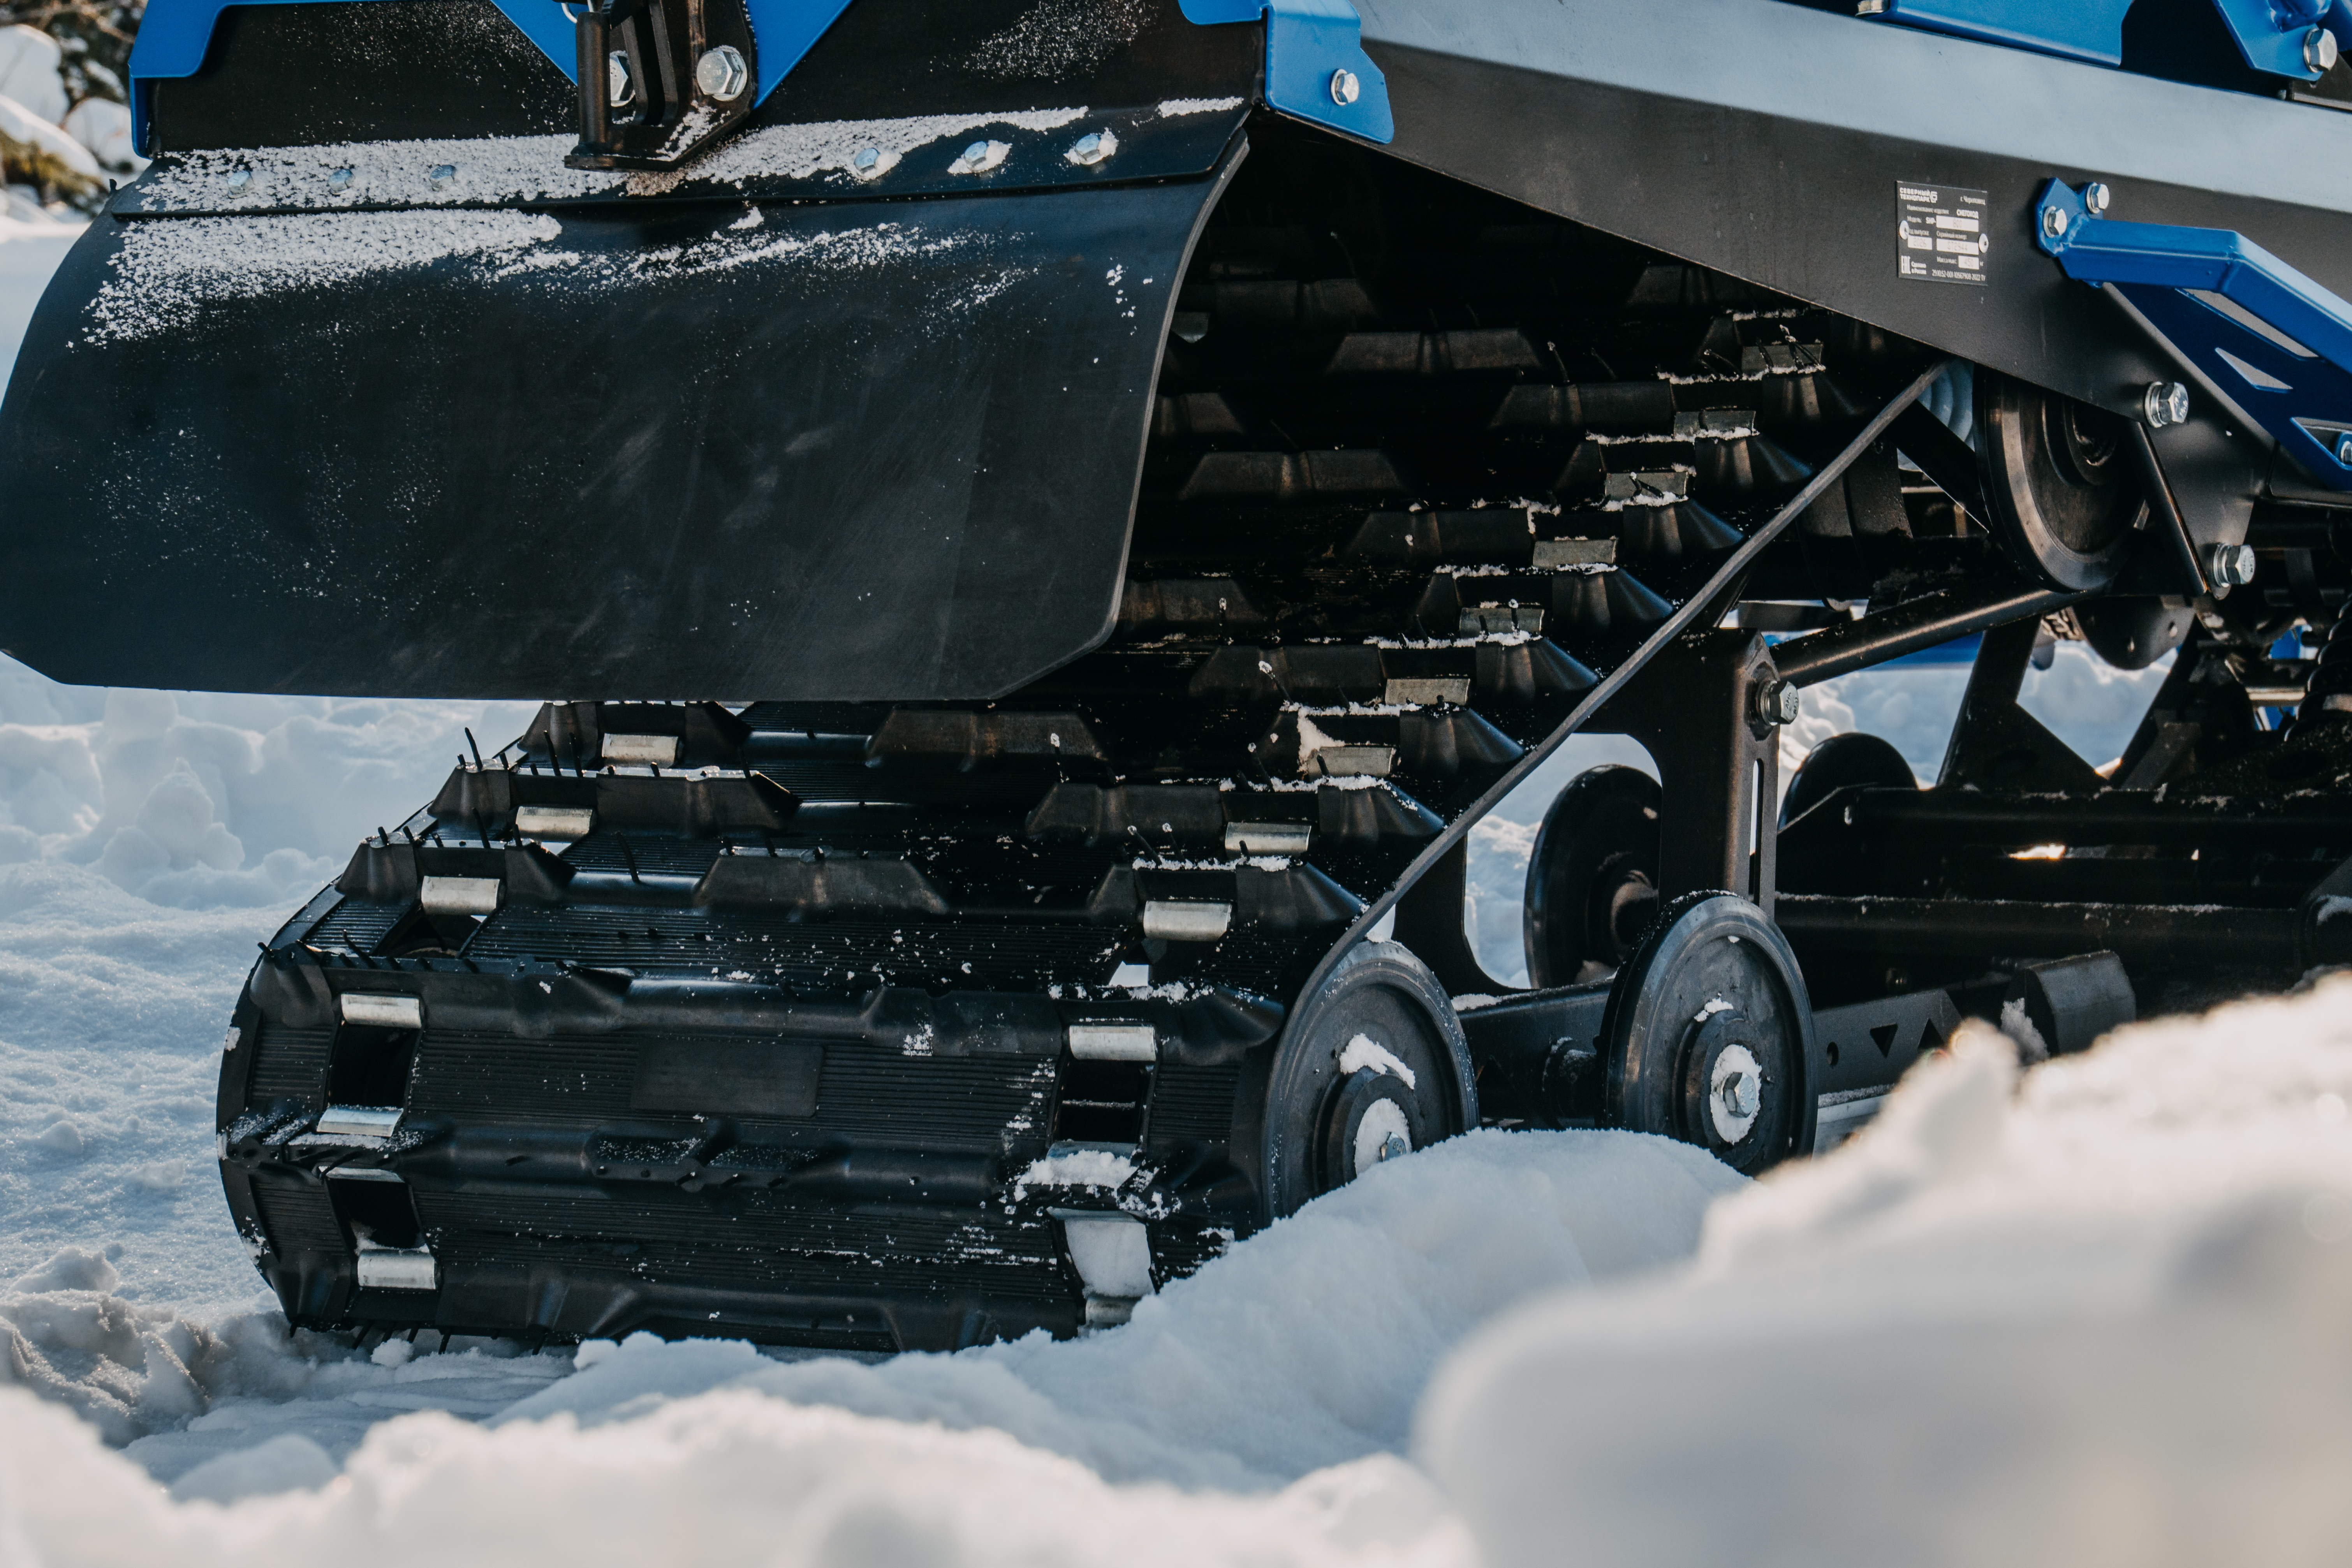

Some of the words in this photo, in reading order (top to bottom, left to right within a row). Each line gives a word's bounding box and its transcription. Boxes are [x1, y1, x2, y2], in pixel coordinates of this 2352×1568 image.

[1900, 187, 1930, 196] СЕВЕРНЫЙ
[1900, 194, 1930, 203] ТЕХНОПАРК
[1956, 209, 1979, 219] СНЕГОХОД
[1913, 238, 1927, 248] 2026
[1964, 257, 1974, 267] 450
